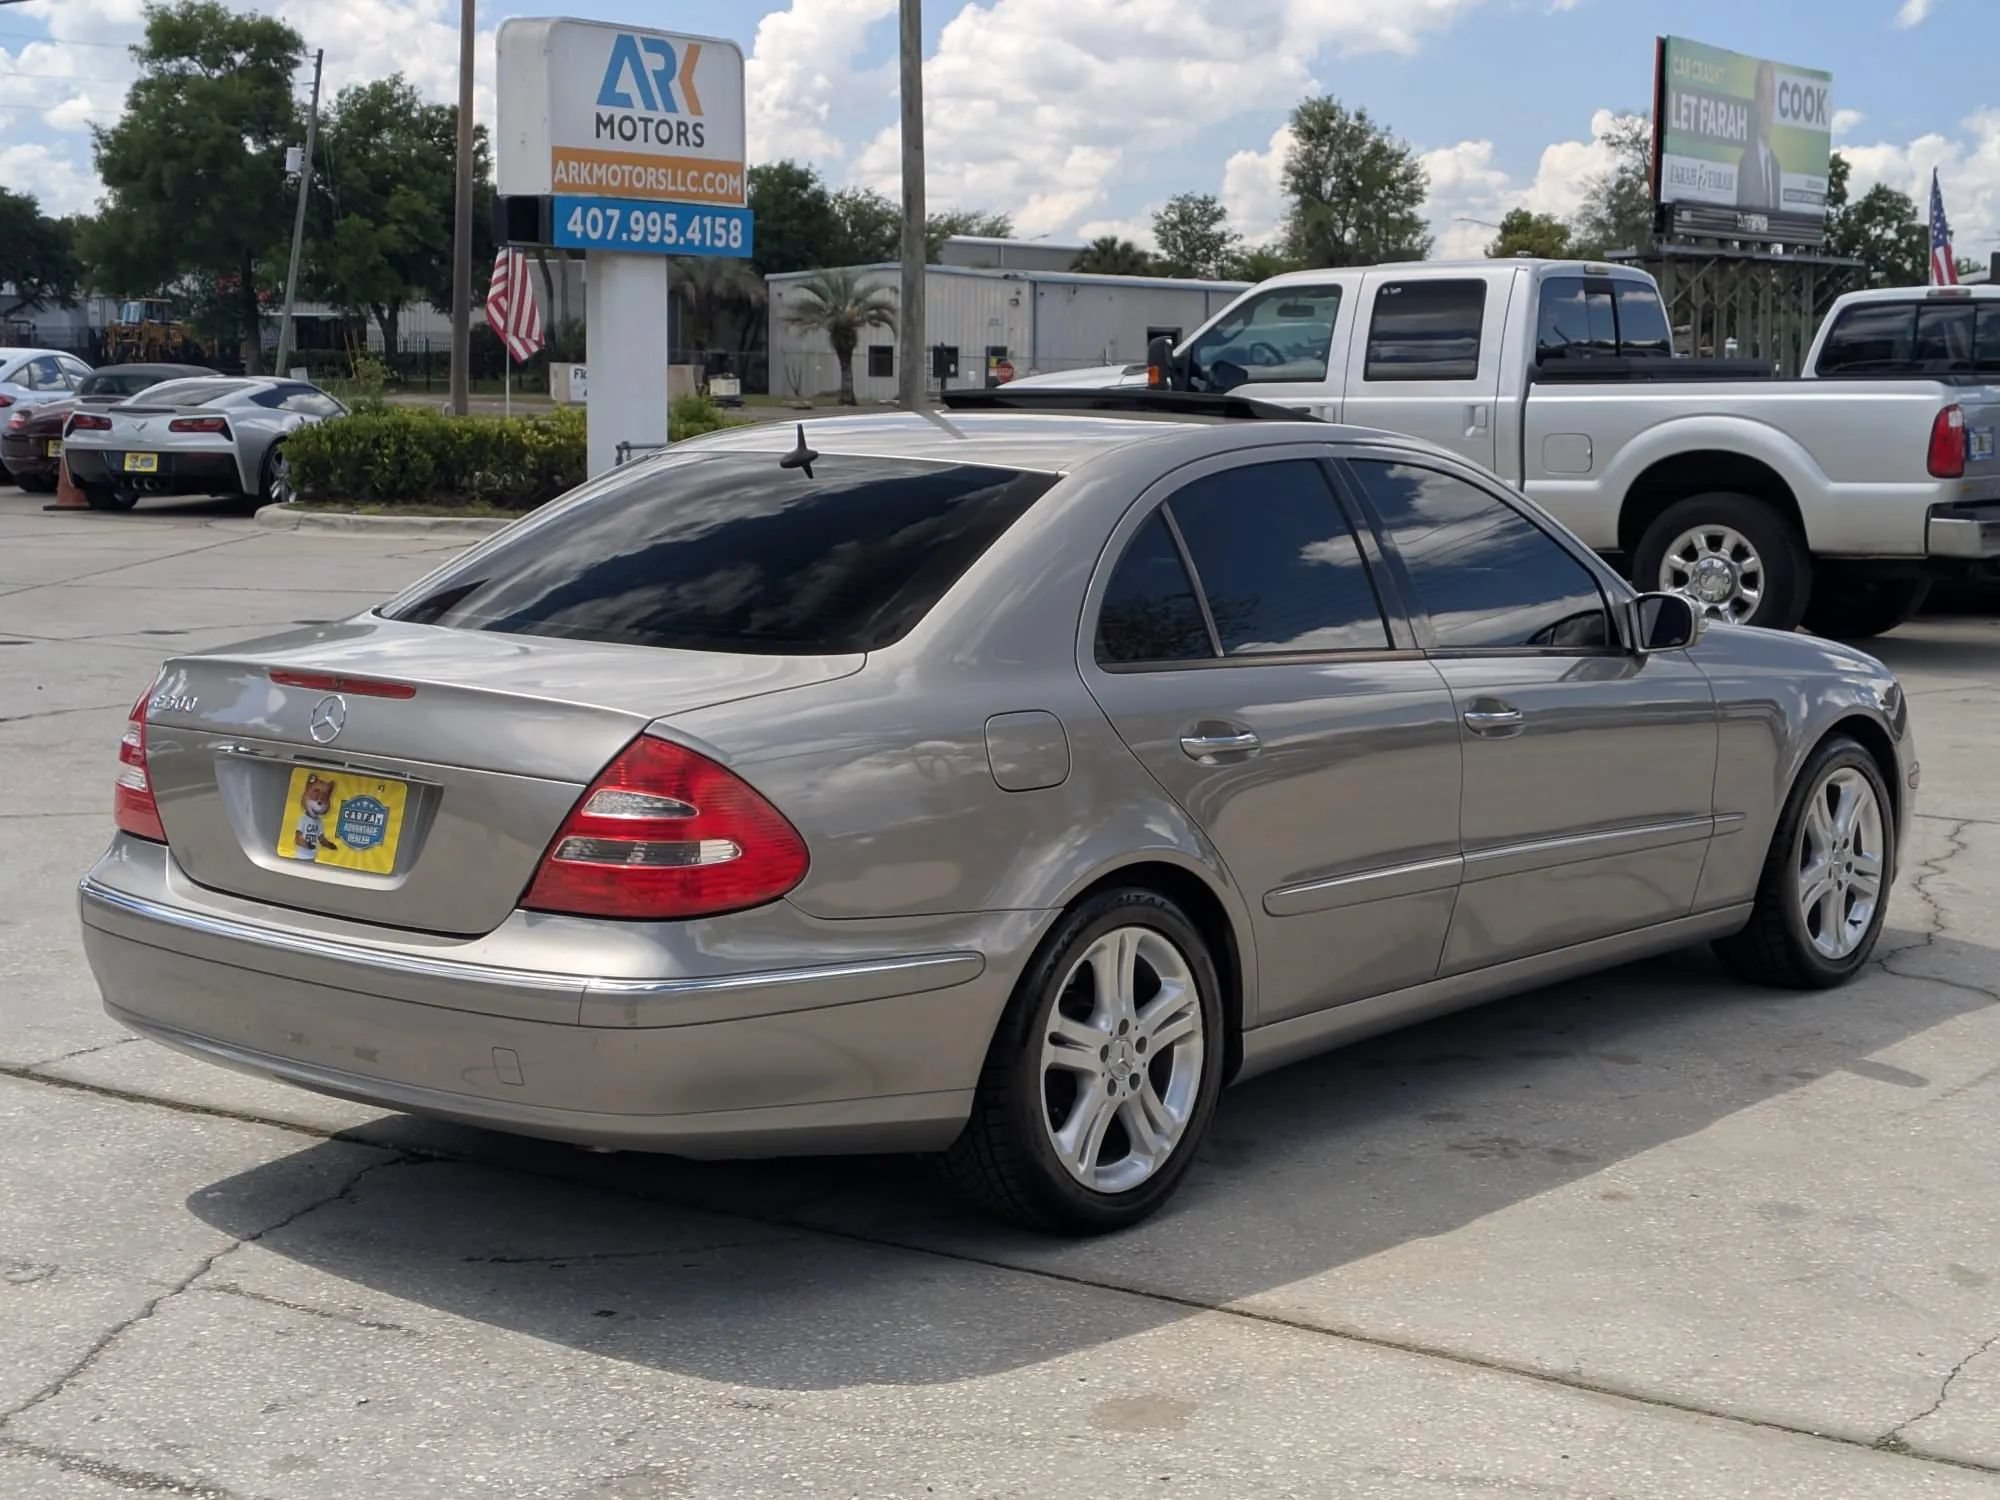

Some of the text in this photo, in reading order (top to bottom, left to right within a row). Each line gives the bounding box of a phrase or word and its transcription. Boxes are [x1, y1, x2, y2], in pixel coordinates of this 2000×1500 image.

[596, 33, 704, 117] ARK
[1671, 92, 1748, 141] LET FARAH
[1778, 80, 1828, 125] COOK
[595, 111, 705, 149] MOTORS
[553, 160, 742, 196] ARKMOTORSLLC.COM
[566, 206, 742, 249] 407.995.4158
